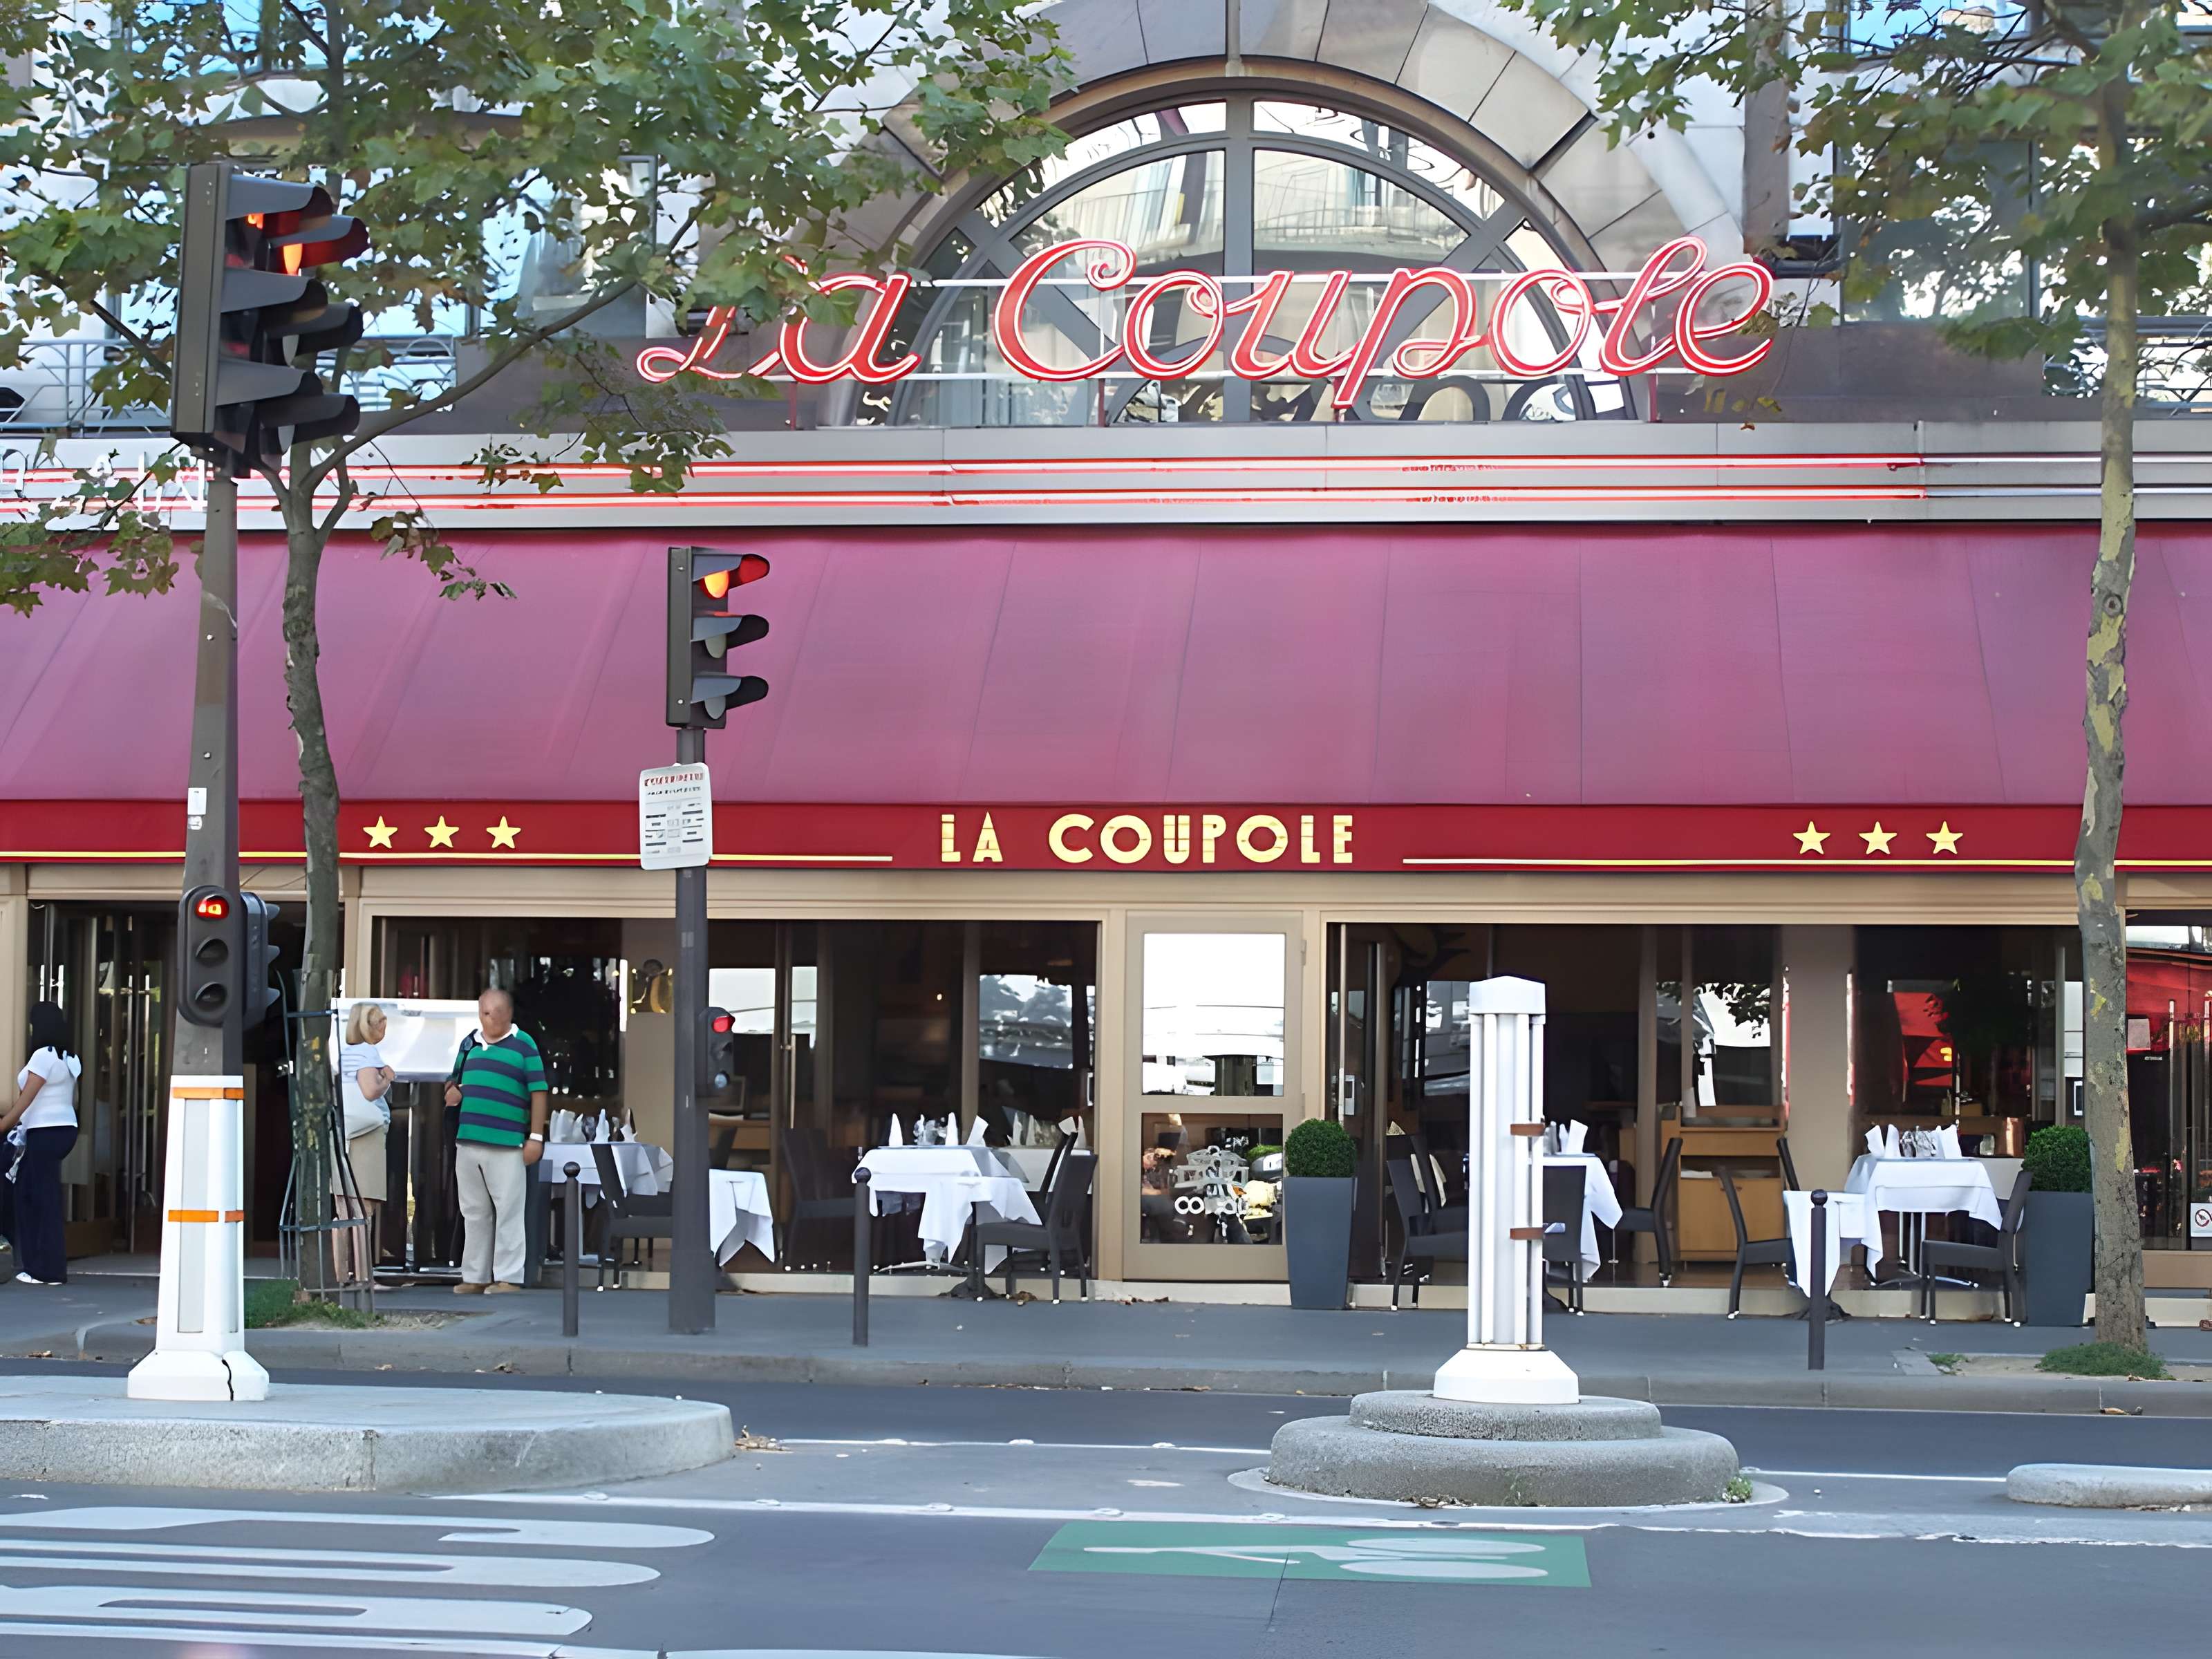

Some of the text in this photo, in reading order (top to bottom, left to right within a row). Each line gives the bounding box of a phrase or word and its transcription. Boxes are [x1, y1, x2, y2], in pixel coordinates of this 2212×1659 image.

[993, 235, 1774, 409] Coupole
[941, 812, 1353, 864] LA COUPOLE
